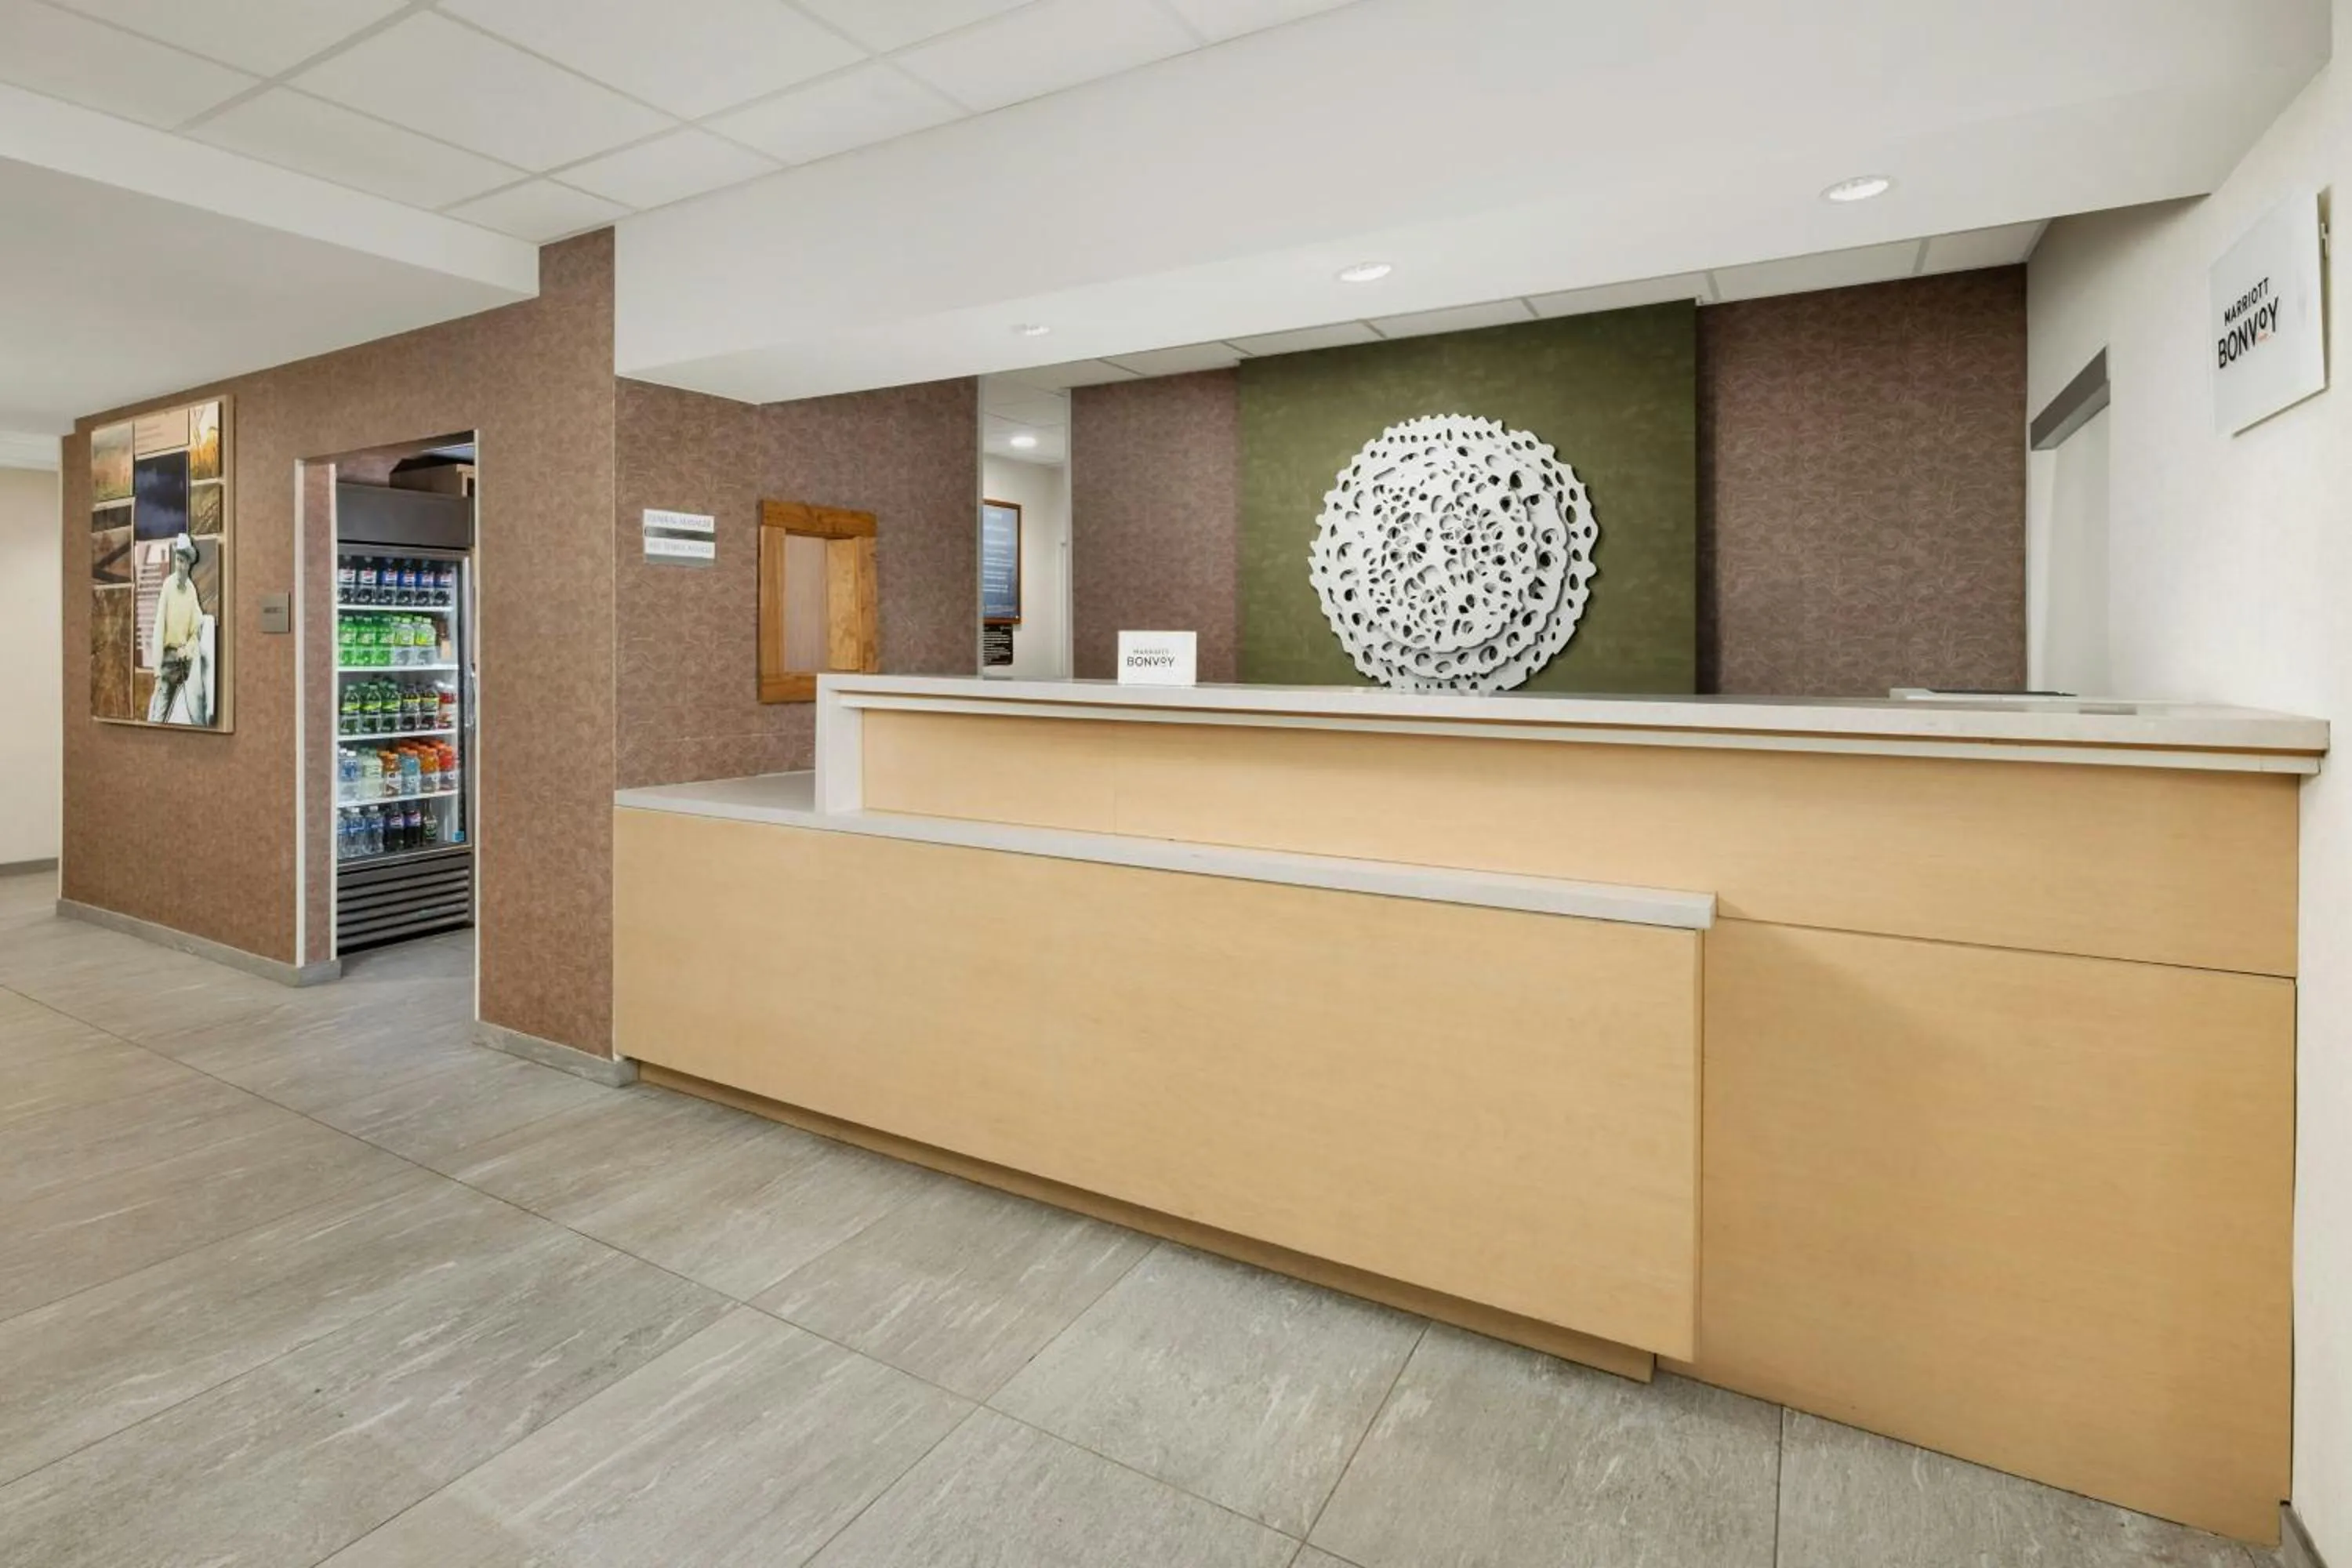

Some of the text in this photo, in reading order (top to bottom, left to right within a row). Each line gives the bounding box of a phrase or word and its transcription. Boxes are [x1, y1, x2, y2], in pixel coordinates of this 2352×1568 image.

[2223, 277, 2270, 326] MARRIOTT
[2218, 296, 2279, 368] BONVOY
[1127, 656, 1175, 667] BONVOY
